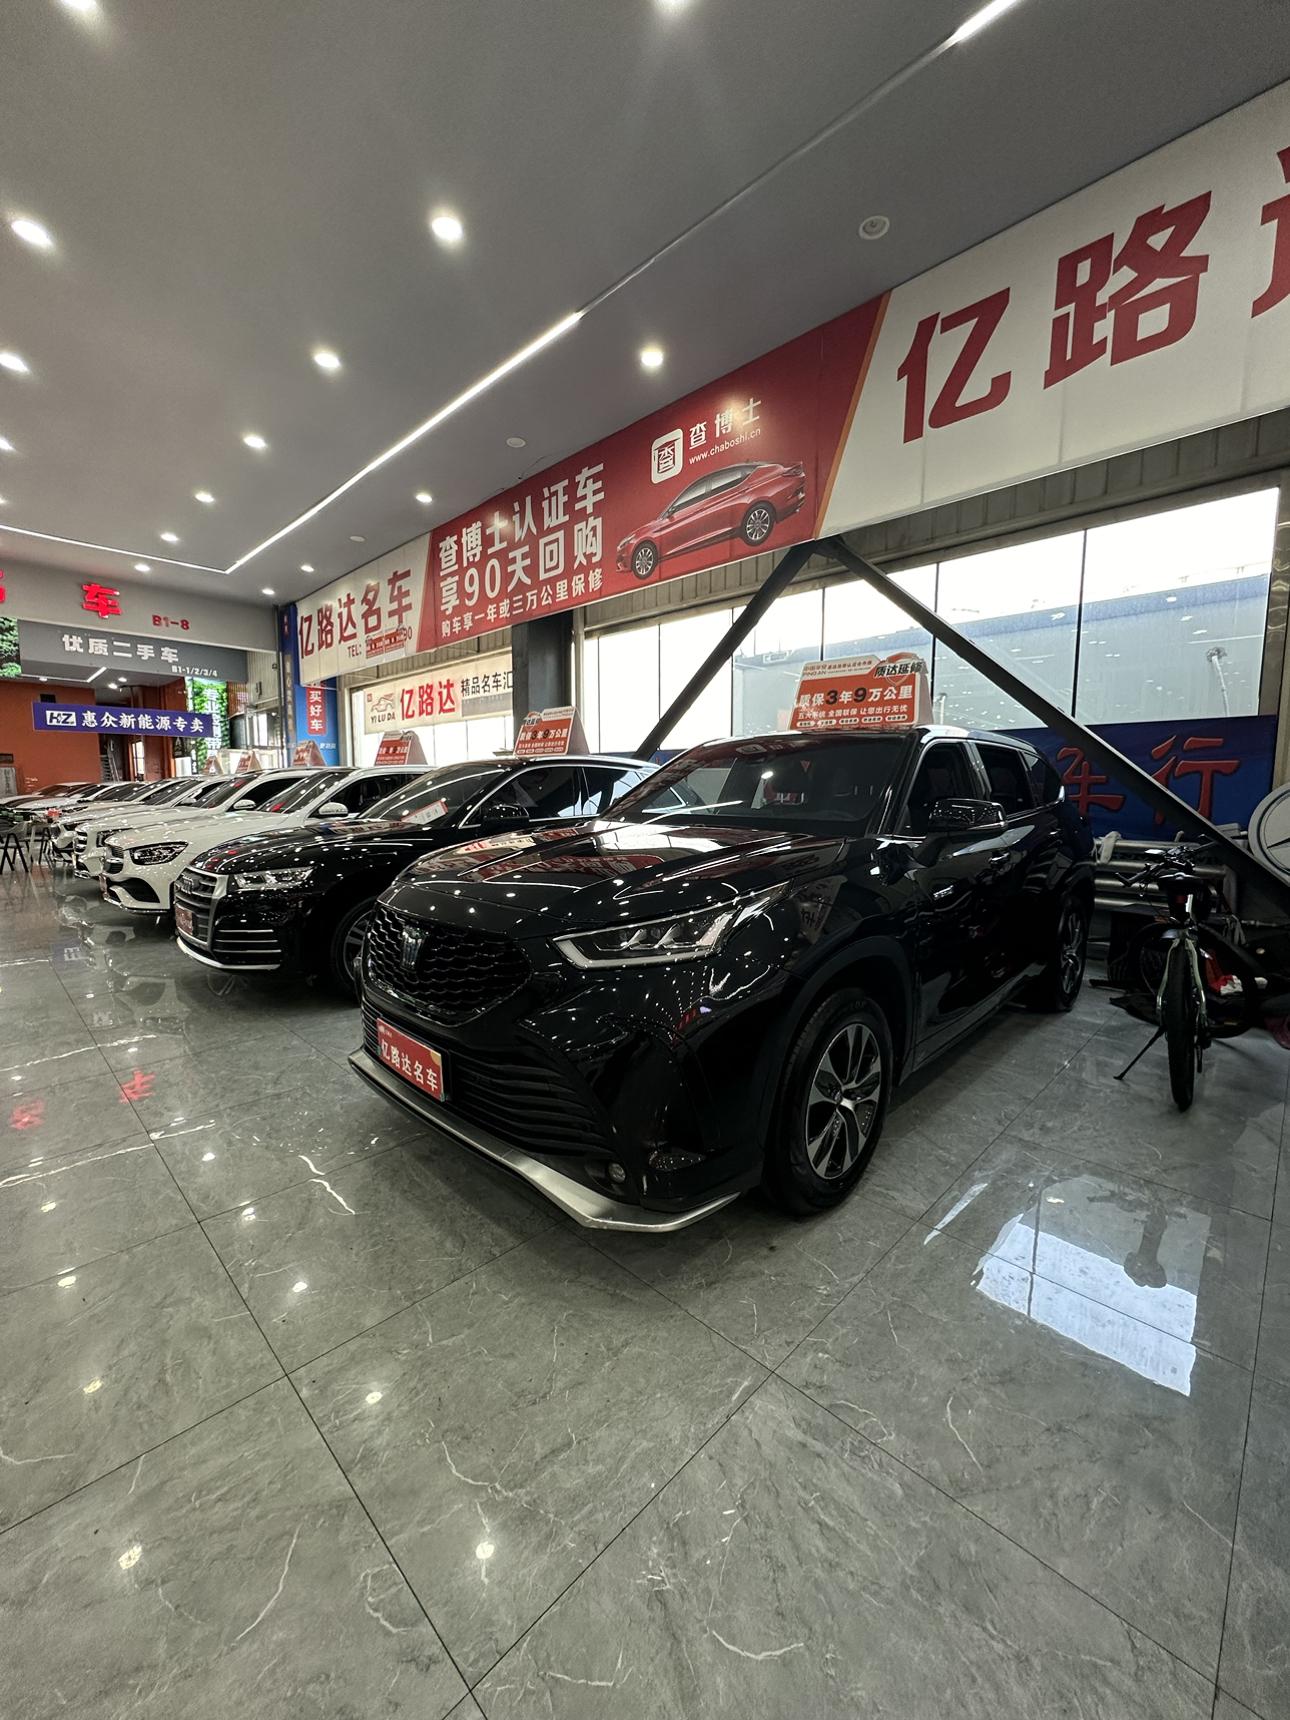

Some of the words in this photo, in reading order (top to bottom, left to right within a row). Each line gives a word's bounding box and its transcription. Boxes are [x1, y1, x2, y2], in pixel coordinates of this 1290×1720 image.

[689, 397, 761, 450] 查博士
[689, 428, 761, 465] www.chaboshi.cn
[439, 463, 605, 576] 查博士认证车
[440, 517, 603, 615] 享90天回购
[152, 615, 190, 630] B1-8
[299, 568, 412, 659] 亿路达名车
[441, 568, 603, 638] 购车享一年或三万公里保修
[62, 634, 179, 664] 优质二手车
[347, 644, 362, 658] TEL:
[400, 678, 455, 721] 亿路达
[461, 671, 513, 697] 精品名车汇
[48, 712, 76, 726] HZ
[82, 709, 204, 733] 惠众新能源专卖
[309, 690, 323, 731] 买好车
[370, 716, 377, 724] YI
[378, 714, 386, 723] LU
[387, 712, 396, 721] DA
[381, 1039, 438, 1091] 亿路达名车
